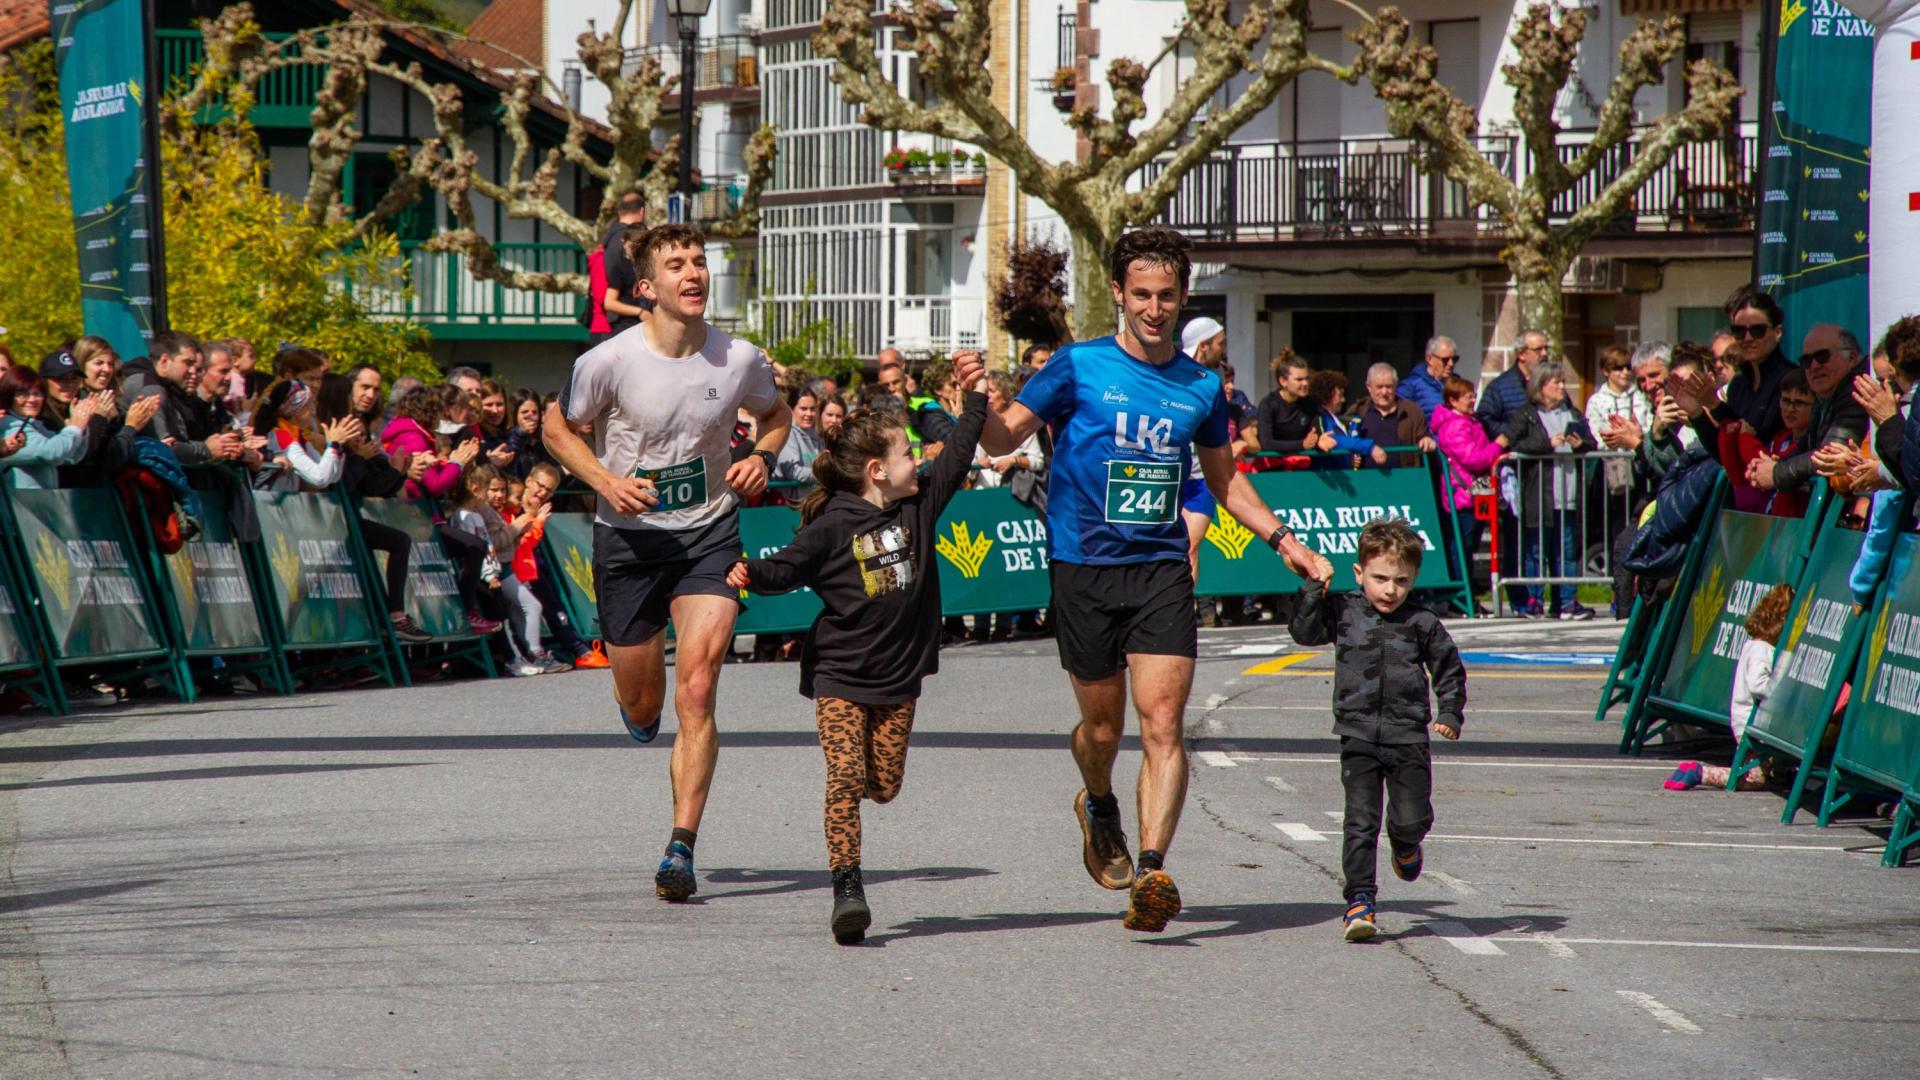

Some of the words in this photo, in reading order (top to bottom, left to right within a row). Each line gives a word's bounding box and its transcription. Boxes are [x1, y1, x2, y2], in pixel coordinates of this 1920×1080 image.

[1118, 488, 1167, 515] 244
[996, 519, 1047, 544] CAJA
[878, 552, 900, 566] WILD
[1001, 547, 1036, 572] DE
[1727, 580, 1754, 618] CAJA
[1712, 622, 1734, 657] DE
